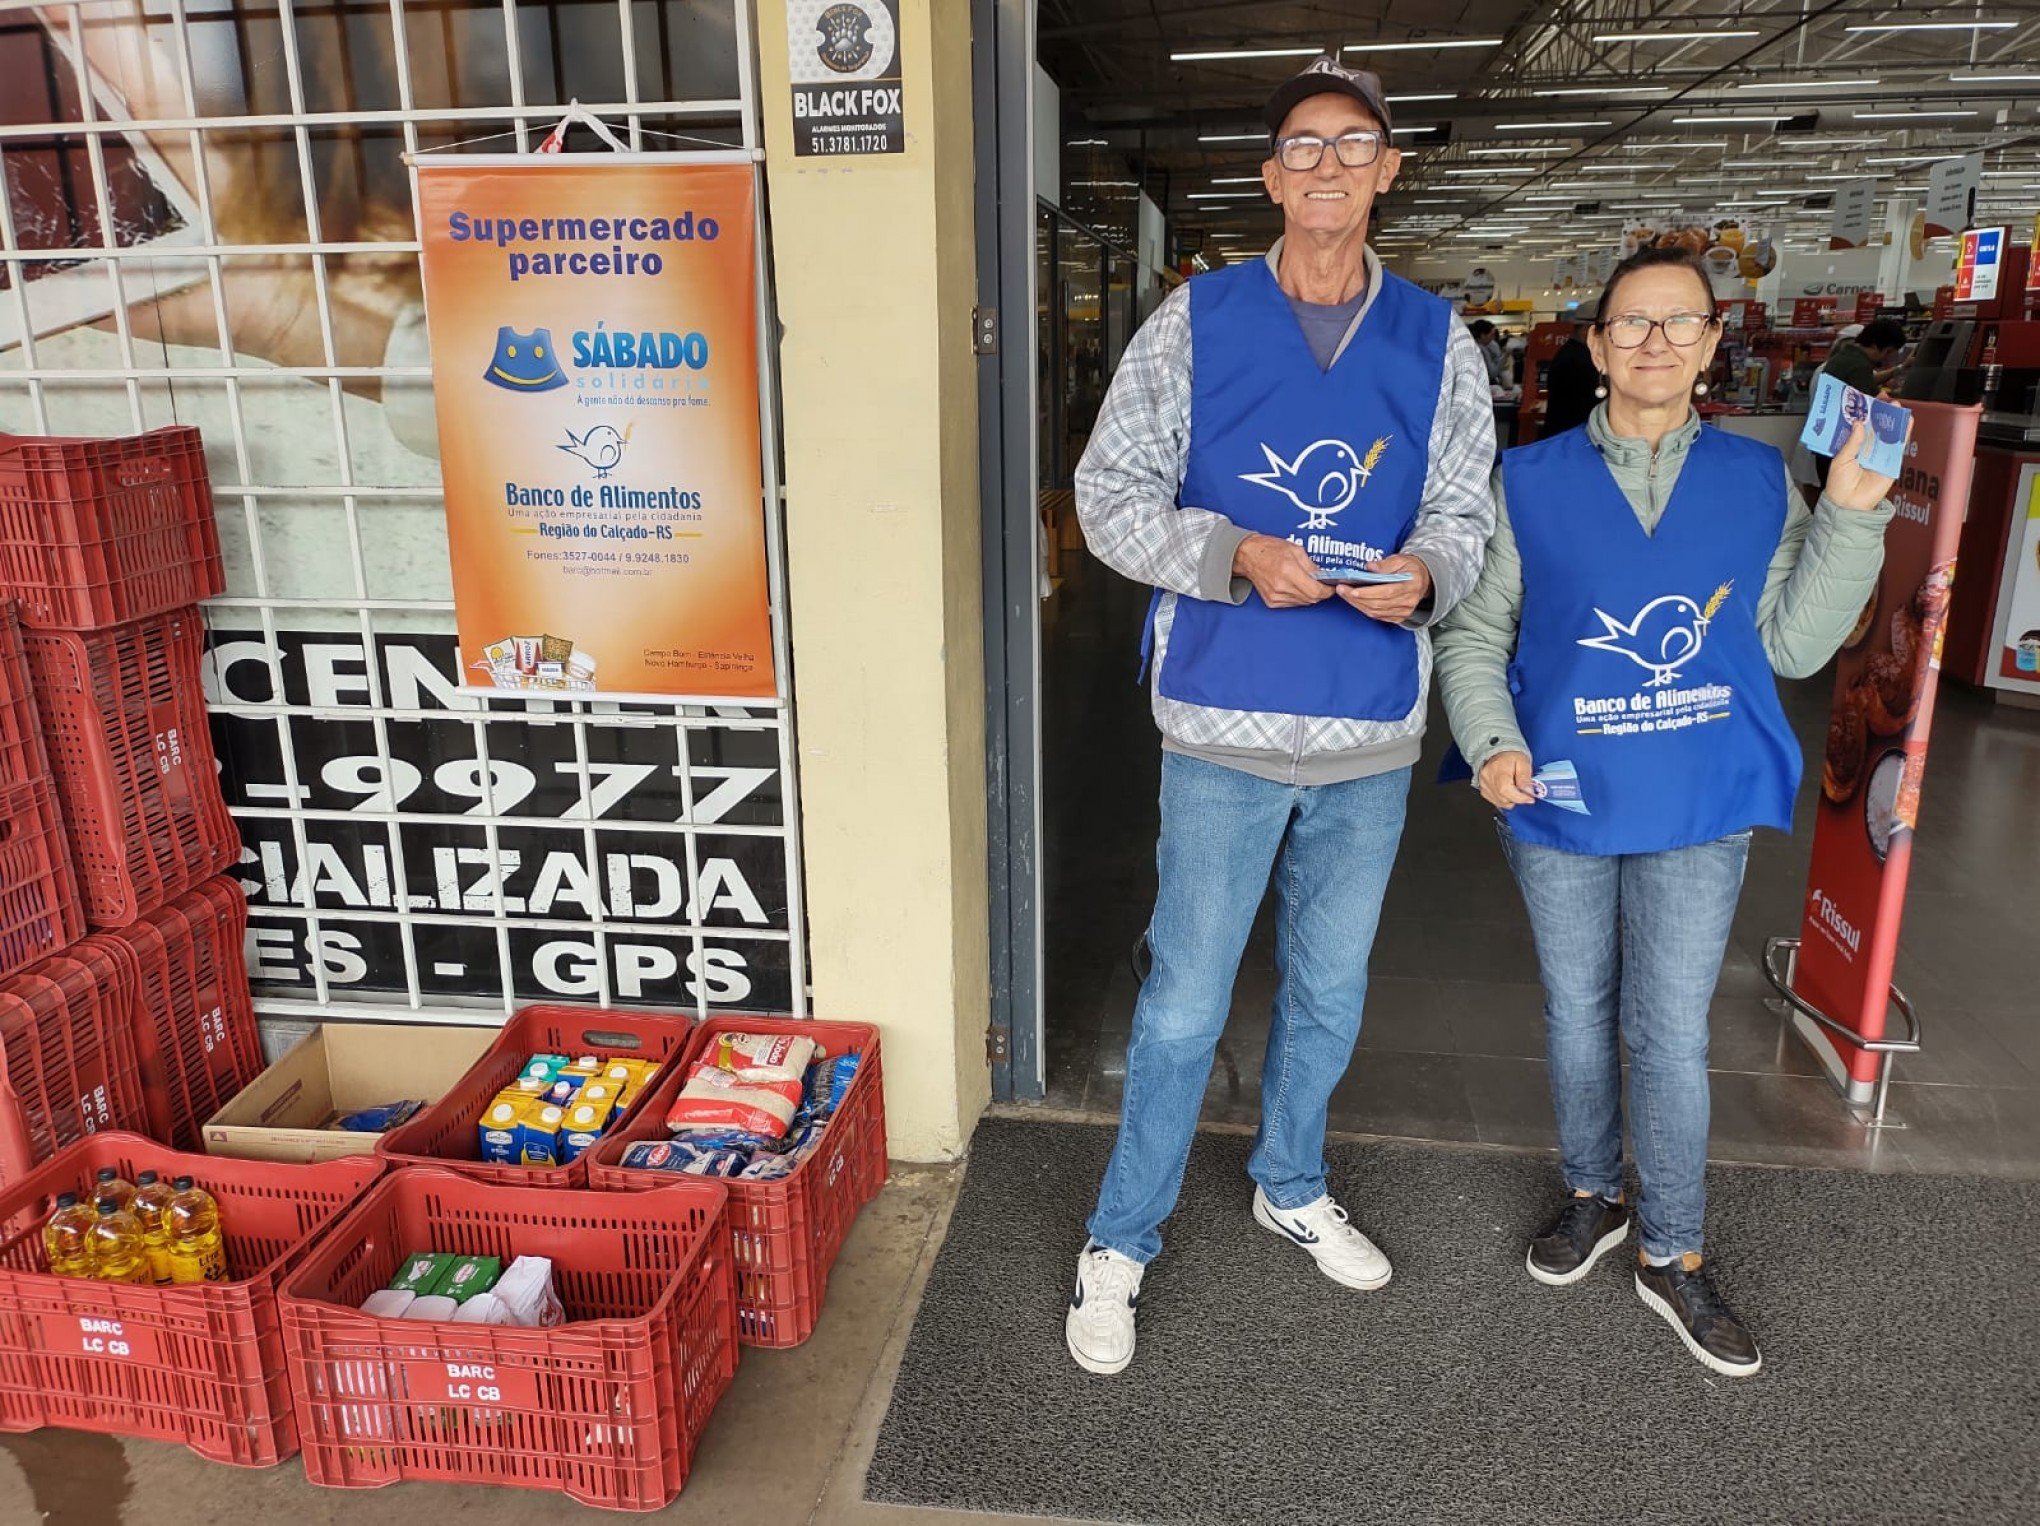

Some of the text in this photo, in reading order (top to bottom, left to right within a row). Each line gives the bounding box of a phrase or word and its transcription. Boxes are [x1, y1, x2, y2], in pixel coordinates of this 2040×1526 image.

[794, 88, 901, 118] BLACK FOX
[841, 123, 887, 132] MONITORADOS
[811, 135, 887, 153] 51.3781.1720
[448, 211, 720, 247] Supermercado
[509, 245, 663, 280] parceiro
[572, 320, 709, 370] SÁBADO
[506, 482, 701, 509] Banco de Alimentos
[508, 508, 530, 518] Uma
[625, 511, 647, 521] pela
[651, 511, 702, 521] cidadania
[540, 522, 580, 539] Região
[583, 523, 598, 537] do
[625, 553, 690, 563] 9.9248.1830
[1307, 534, 1385, 562] Alimentos
[1574, 683, 1733, 715] Banco de Alimentos
[1576, 714, 1596, 724] Uma
[1621, 707, 1674, 720] empresarial
[1603, 722, 1639, 736] Região
[1640, 720, 1654, 732] do
[155, 732, 166, 751] LC
[166, 729, 182, 766] BARC
[1820, 899, 1862, 954] Rissul
[532, 941, 752, 1004] GPS
[201, 1014, 210, 1032] LC
[211, 1006, 226, 1042] BARC
[80, 1094, 91, 1114] LC
[93, 1085, 109, 1124] BARC
[79, 1317, 123, 1336] BARC
[82, 1336, 130, 1356] LC CB
[446, 1364, 496, 1380] BARC
[448, 1384, 501, 1401] LC CB
